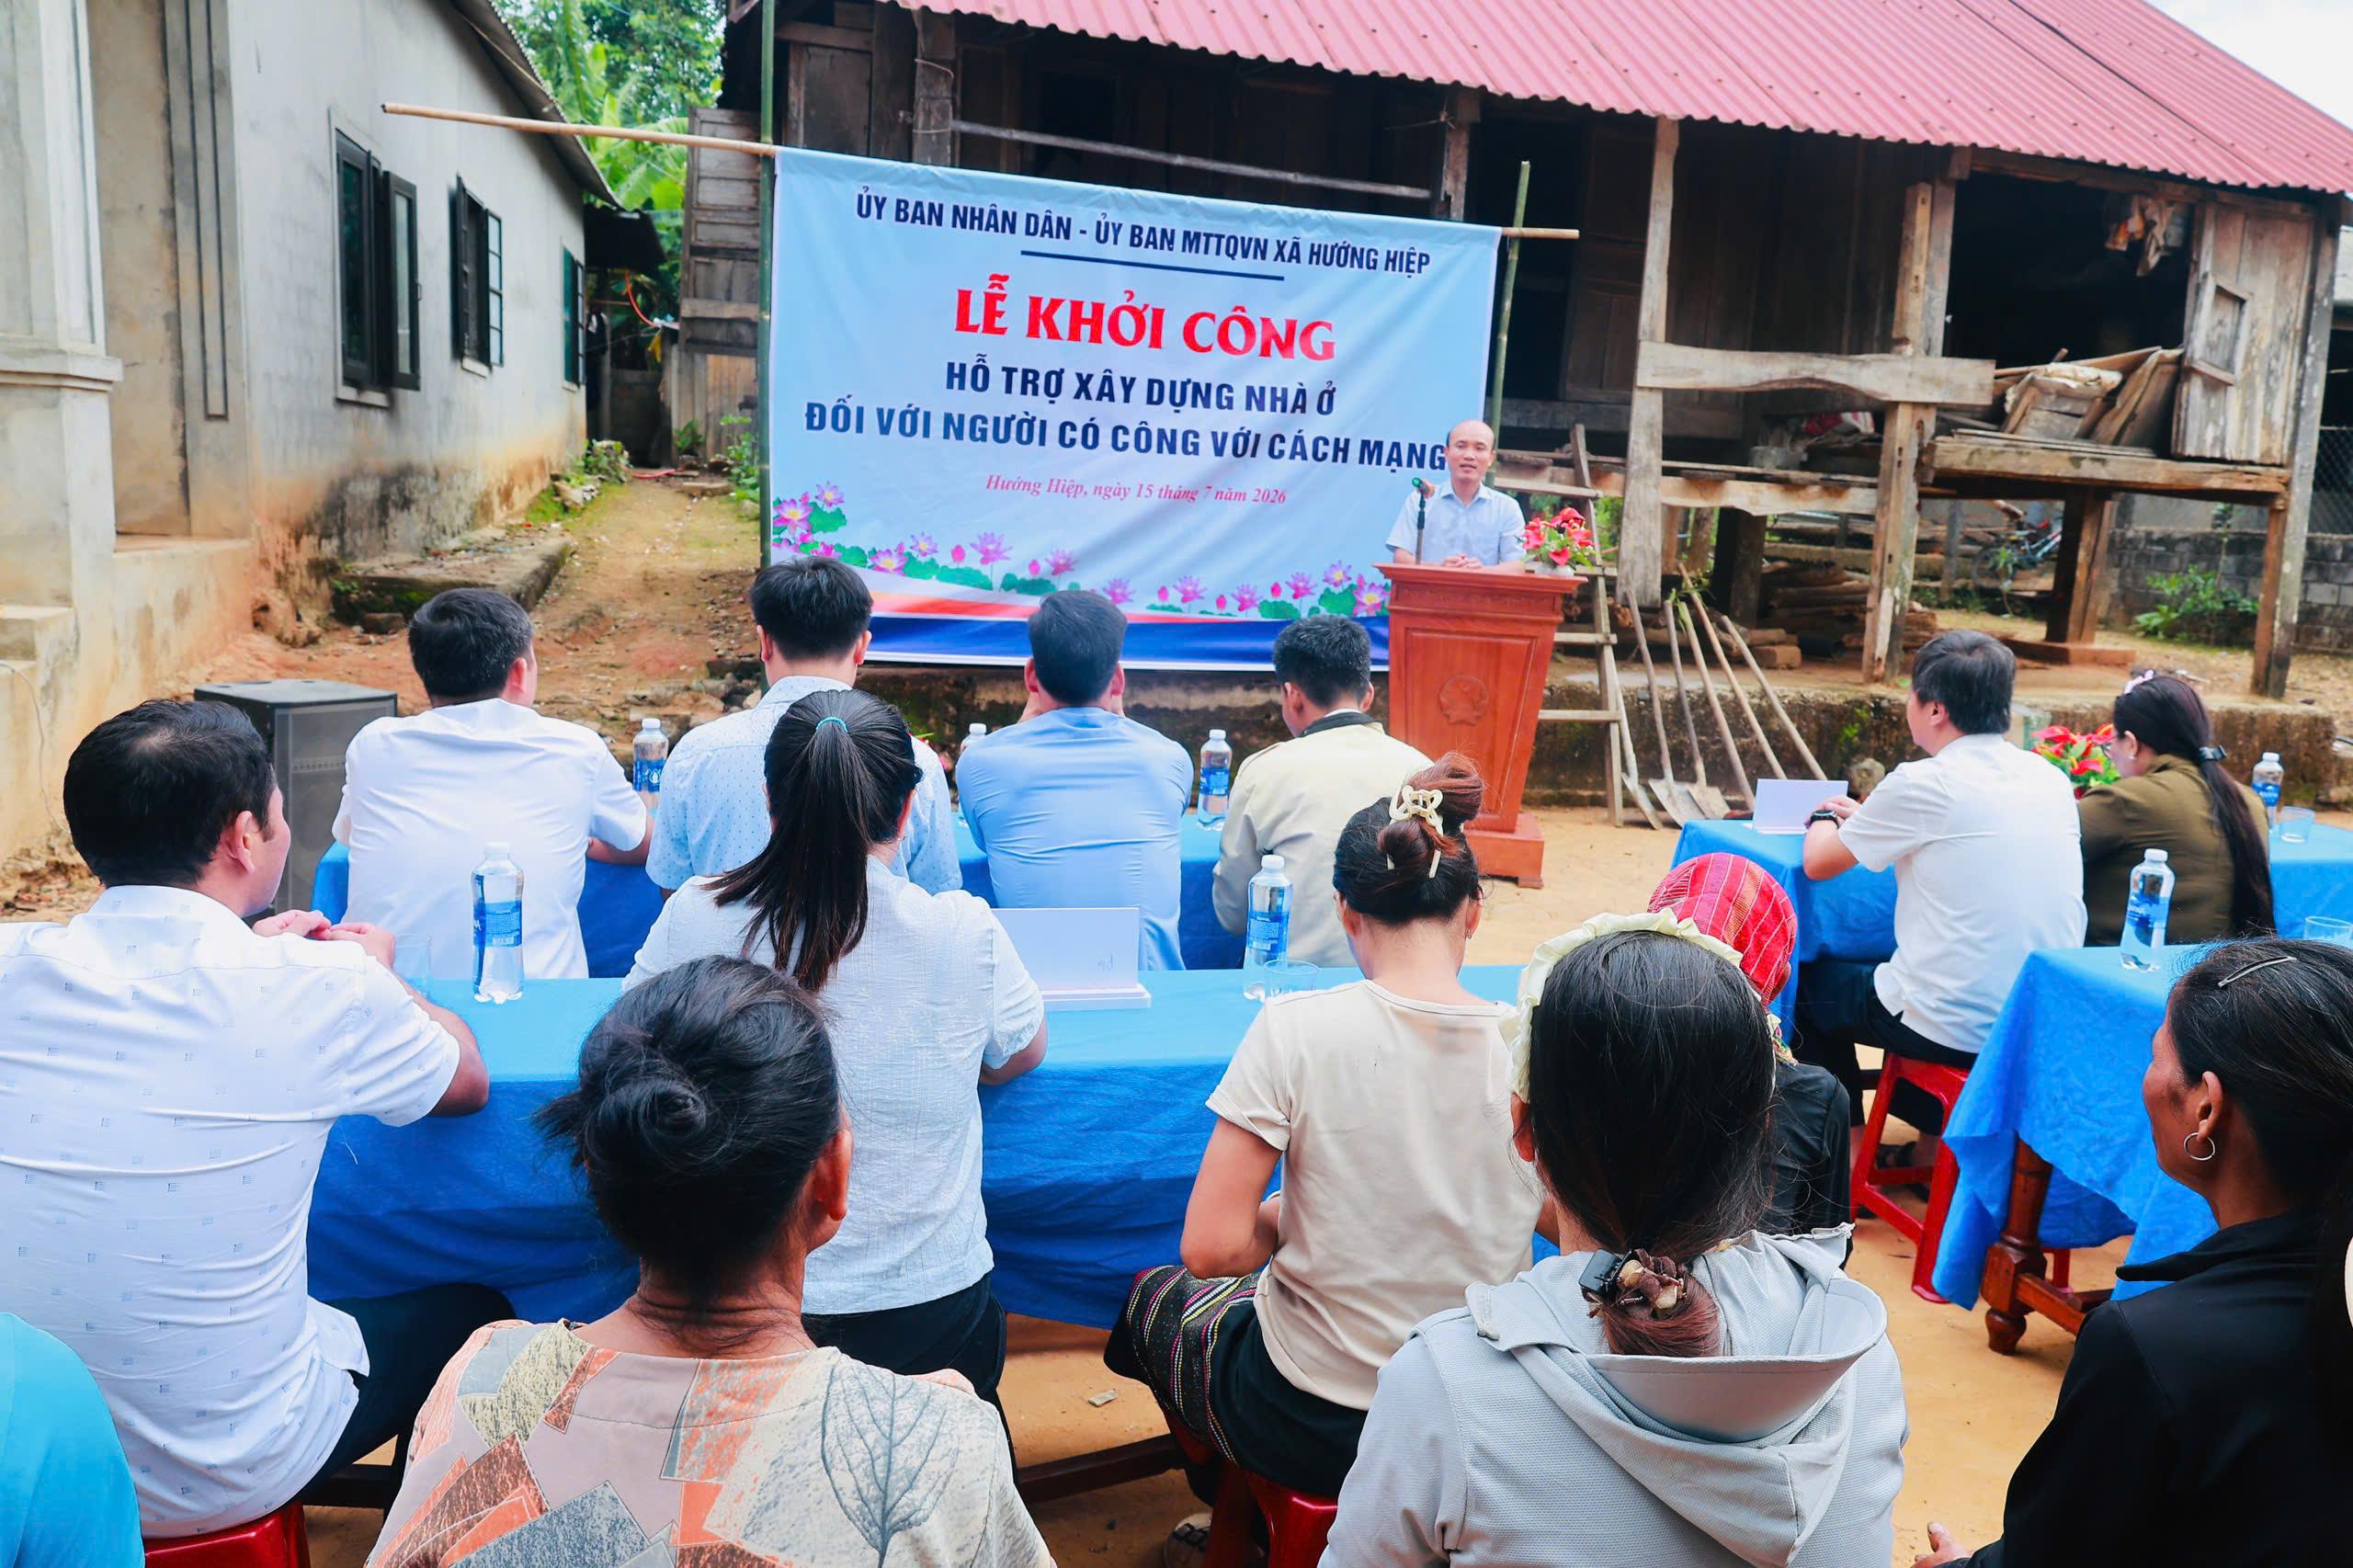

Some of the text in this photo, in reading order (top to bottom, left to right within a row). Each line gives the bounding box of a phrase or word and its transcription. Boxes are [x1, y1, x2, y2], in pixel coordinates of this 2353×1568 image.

[857, 186, 887, 220] ỦY
[894, 198, 944, 226] BAN
[951, 203, 1017, 234] NHÂN
[1024, 210, 1072, 240] DÂN
[1095, 212, 1123, 245] ỦY
[1130, 223, 1176, 251] BAN
[1181, 230, 1268, 261] MTTQVN
[1273, 236, 1302, 264] XÃ
[1308, 240, 1379, 270] HƯỚNG
[1384, 246, 1430, 278] HIỆP
[954, 273, 1336, 361] LỄ KHỞI CÔNG
[946, 353, 1336, 415] HỖ TRỢ XÂY DỰNG NHÀ Ở
[805, 394, 1447, 473] ĐỐI VỚI NGƯỜI CÓ CÔNG VỚI CÁCH MẠNG
[985, 474, 1041, 496] Hướng
[1093, 482, 1131, 501] ngày
[1136, 483, 1153, 499] 15
[1158, 485, 1199, 503] tháng
[1205, 485, 1212, 500] 7
[1214, 487, 1246, 503] năm
[1252, 488, 1288, 505] 2026
